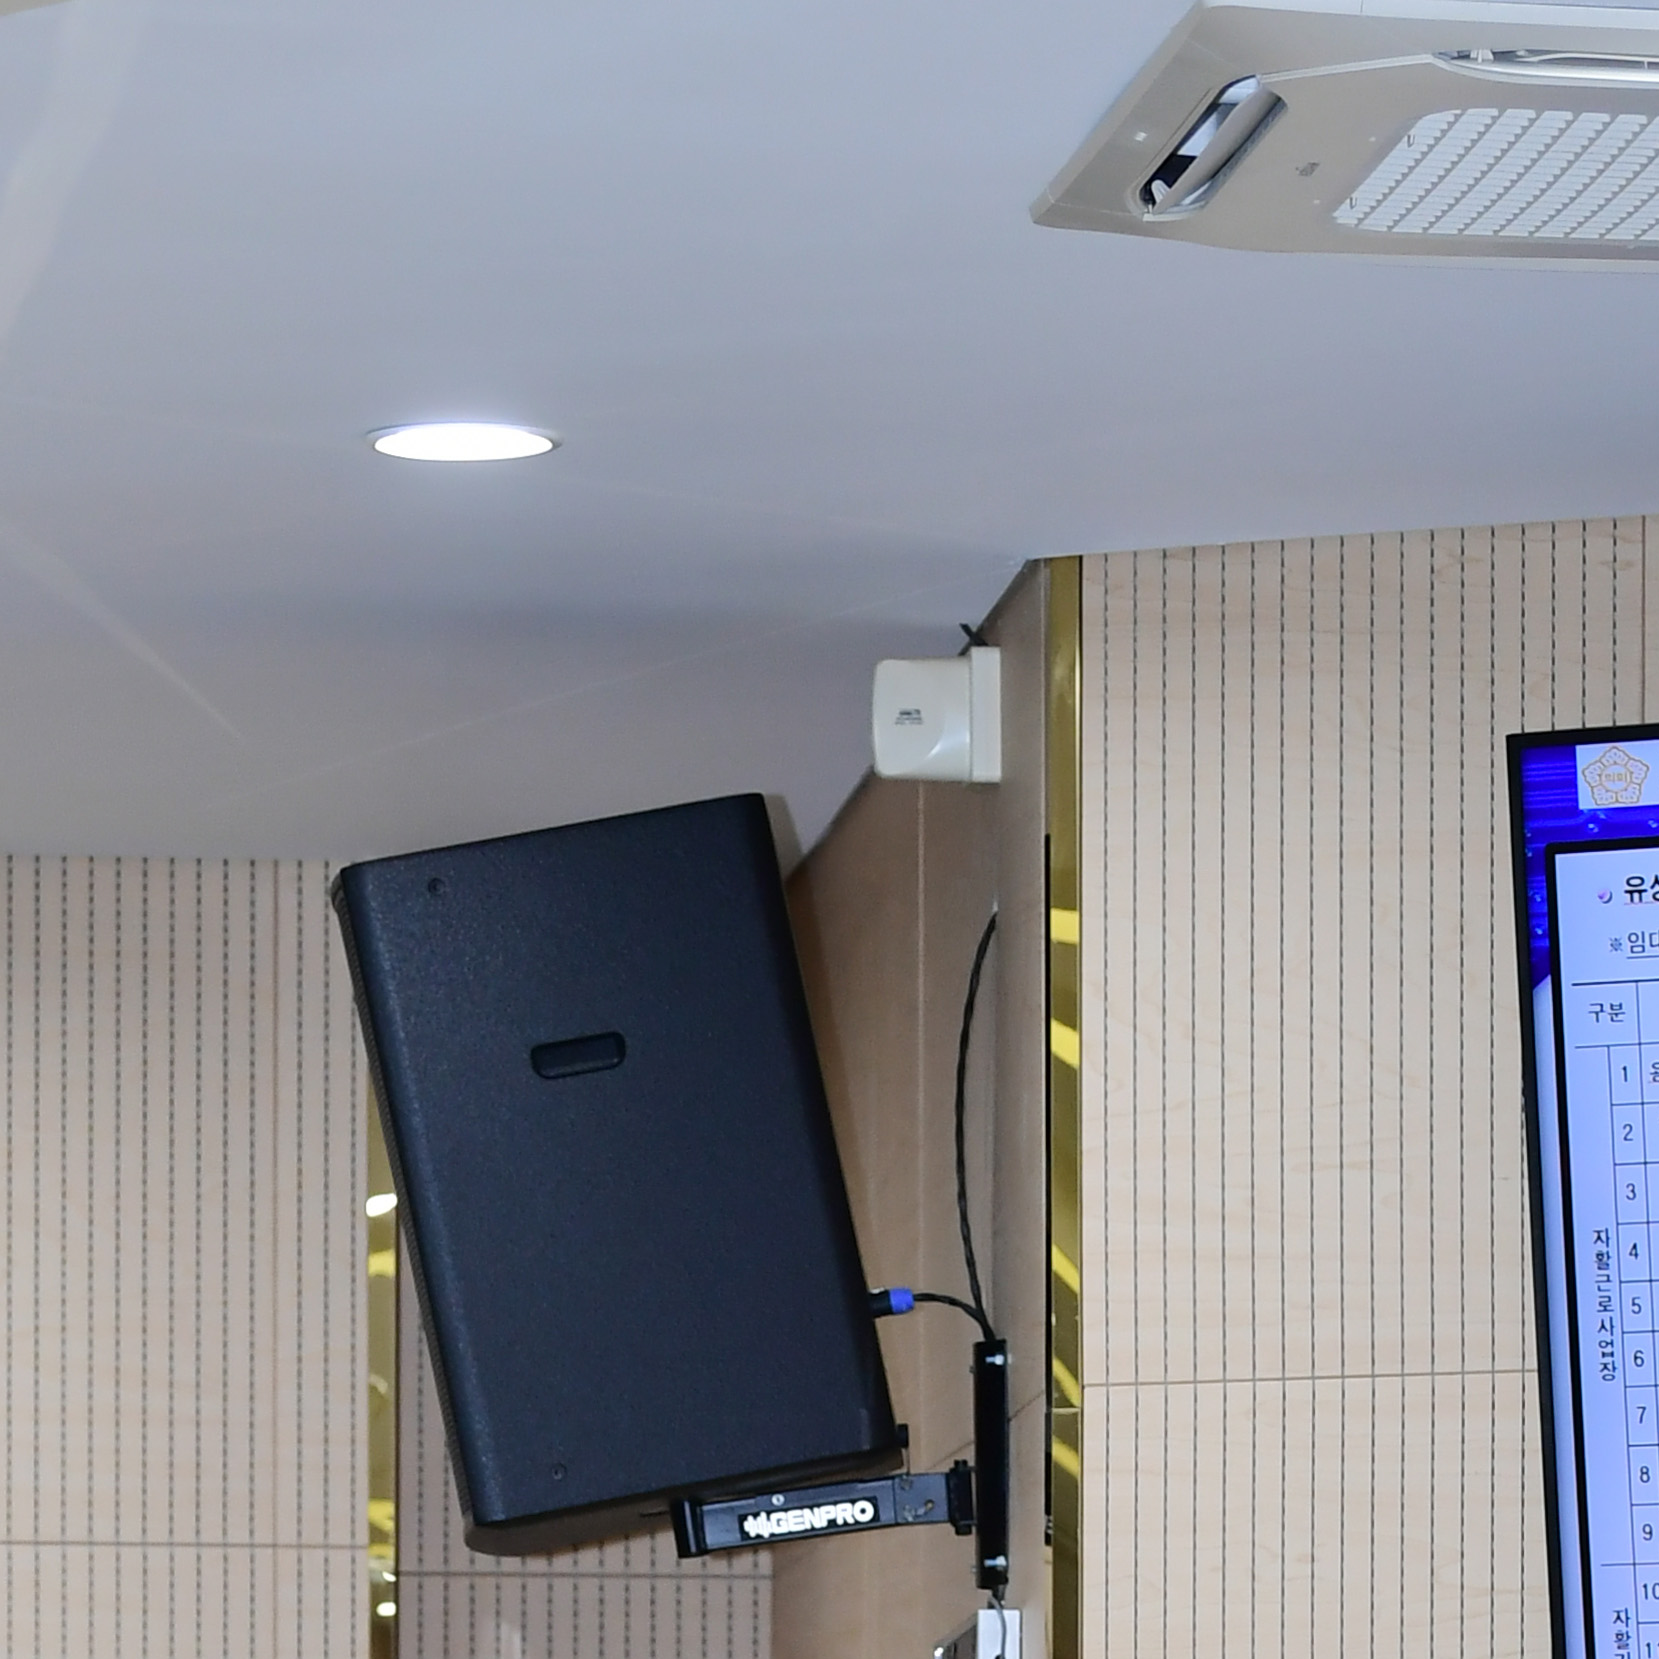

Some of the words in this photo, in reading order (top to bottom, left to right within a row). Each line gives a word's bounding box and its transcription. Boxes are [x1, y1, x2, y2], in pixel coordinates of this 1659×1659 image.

[1588, 1002, 1625, 1022] 구분
[1622, 1067, 1629, 1083] 1
[1622, 1124, 1634, 1141] 2
[1625, 1184, 1636, 1201] 3
[1628, 1242, 1639, 1260] 4
[1631, 1297, 1642, 1315] 5
[1634, 1351, 1644, 1368] 6
[1636, 1407, 1646, 1424] 7
[1639, 1467, 1650, 1484] 8
[770, 1500, 875, 1535] GENPRO
[1642, 1523, 1653, 1541] 9
